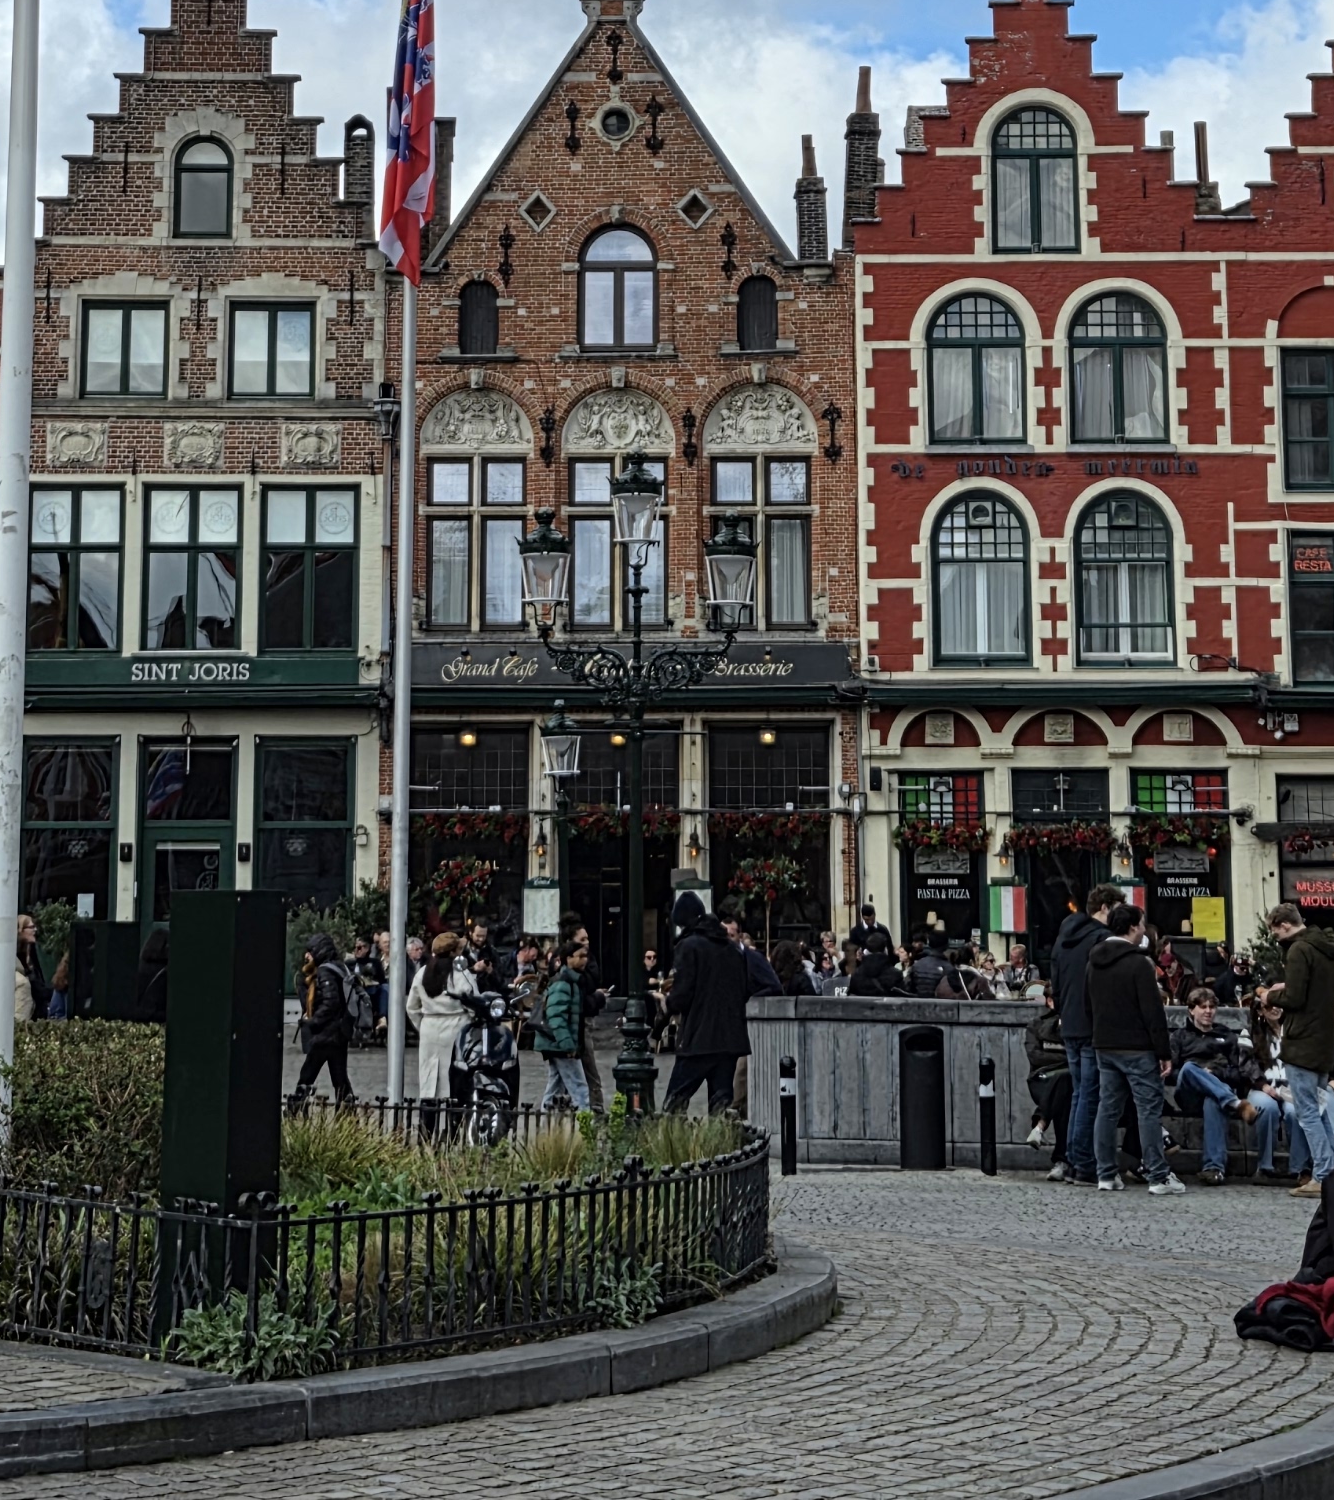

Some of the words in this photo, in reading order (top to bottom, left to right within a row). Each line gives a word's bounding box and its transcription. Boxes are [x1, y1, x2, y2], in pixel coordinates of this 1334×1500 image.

[131, 663, 181, 681] SINT
[189, 663, 250, 681] JORIS
[441, 656, 498, 683] Grand
[917, 888, 940, 899] PASTA
[948, 888, 970, 899] PIZZA
[1157, 886, 1181, 897] PASTA
[1188, 886, 1211, 897] PIZZA
